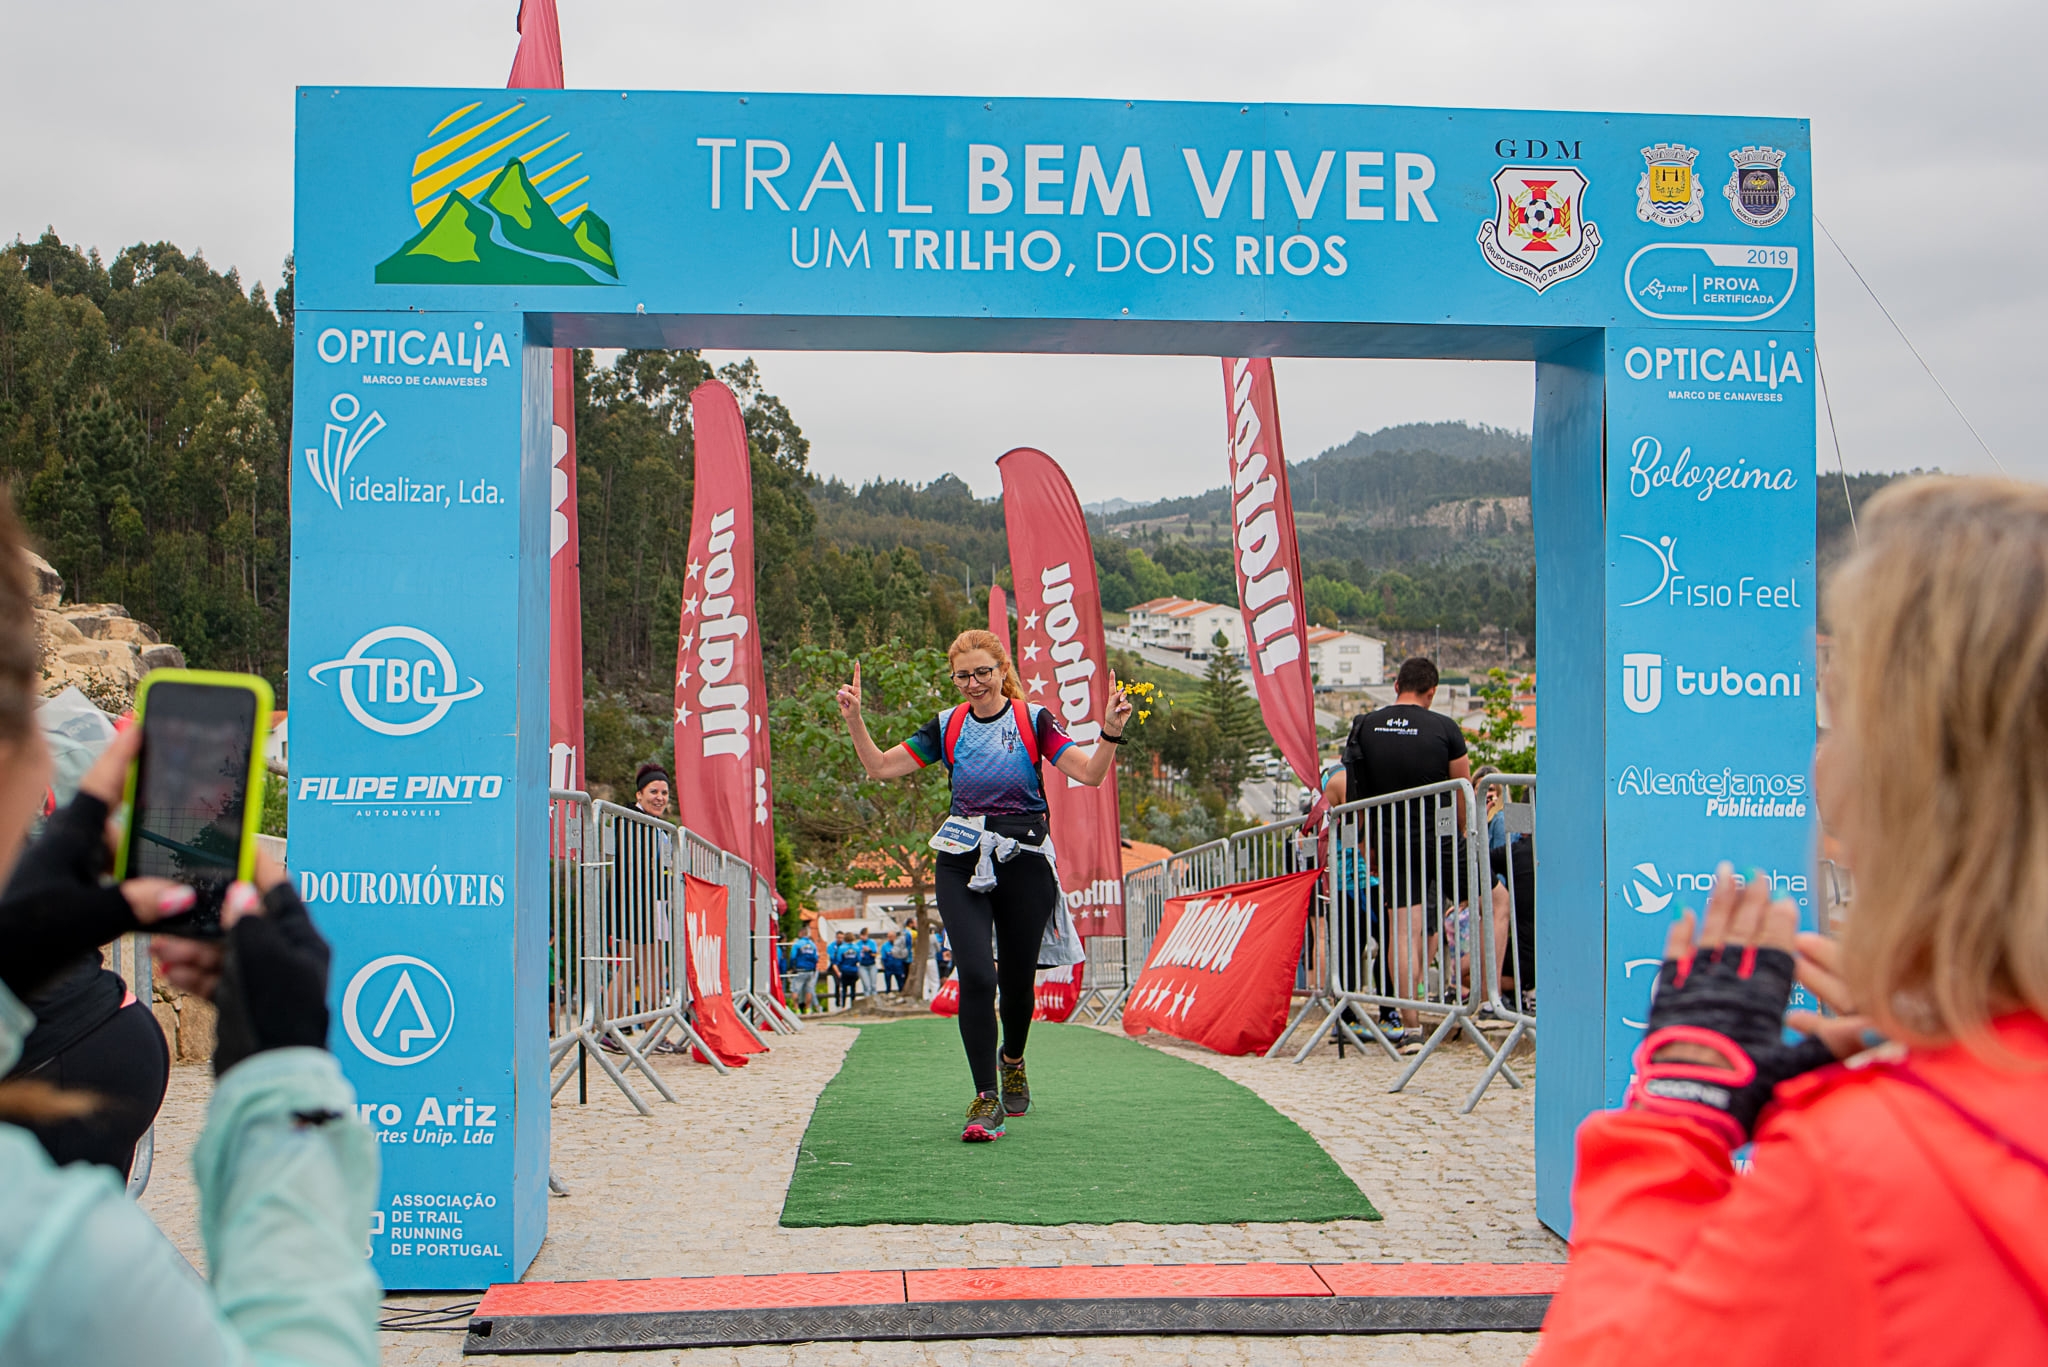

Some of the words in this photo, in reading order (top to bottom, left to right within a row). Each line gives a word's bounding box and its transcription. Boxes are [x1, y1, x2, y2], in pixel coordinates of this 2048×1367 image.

[696, 137, 932, 214] TRAIL
[967, 143, 1151, 217] BEM
[1182, 148, 1439, 223] VIVER
[1651, 211, 1666, 224] BEM
[1669, 212, 1689, 224] VIVER
[1736, 208, 1752, 223] MARCO
[790, 225, 871, 270] UM
[887, 228, 1076, 277] TRILHO,
[1096, 231, 1214, 275] DOIS
[1235, 235, 1348, 277] RIOS
[1747, 249, 1788, 265] 2019
[1486, 241, 1507, 265] GRUPO
[1505, 260, 1548, 284] DESPORTIVO
[1548, 265, 1558, 276] DE
[1558, 243, 1591, 272] MAGRELOS
[1703, 277, 1760, 291] PROVA
[1703, 294, 1775, 304] CERTIFICADA
[363, 375, 403, 385] MARCO
[405, 376, 420, 385] DE
[423, 376, 488, 387] CANAVESES
[1668, 391, 1705, 400] MARCO
[1708, 391, 1722, 400] DE
[1723, 392, 1783, 402] CANAVESES
[1629, 435, 1799, 502] Bolozeima
[350, 475, 451, 509] idealizar,
[458, 478, 505, 504] Lda.
[360, 657, 436, 704] TBC
[1676, 665, 1801, 697] tubani
[297, 776, 399, 800] FILIPE
[404, 775, 503, 799] PINTO
[1617, 764, 1807, 802] Alentejanos
[356, 808, 442, 817] AUTOMÓVEIS
[1705, 797, 1807, 818] Publicidade
[299, 863, 506, 907] DOUROMÓVEIS
[415, 1096, 497, 1127] Ariz
[412, 1128, 458, 1147] Unip.
[463, 1129, 495, 1145] Lda
[391, 1192, 497, 1210] ASSOCIAÇÃO
[391, 1212, 414, 1223] DE
[417, 1212, 463, 1224] TRAIL
[391, 1228, 464, 1240] RUNNING
[391, 1244, 414, 1256] DE
[416, 1245, 503, 1257] PORTUGAL
